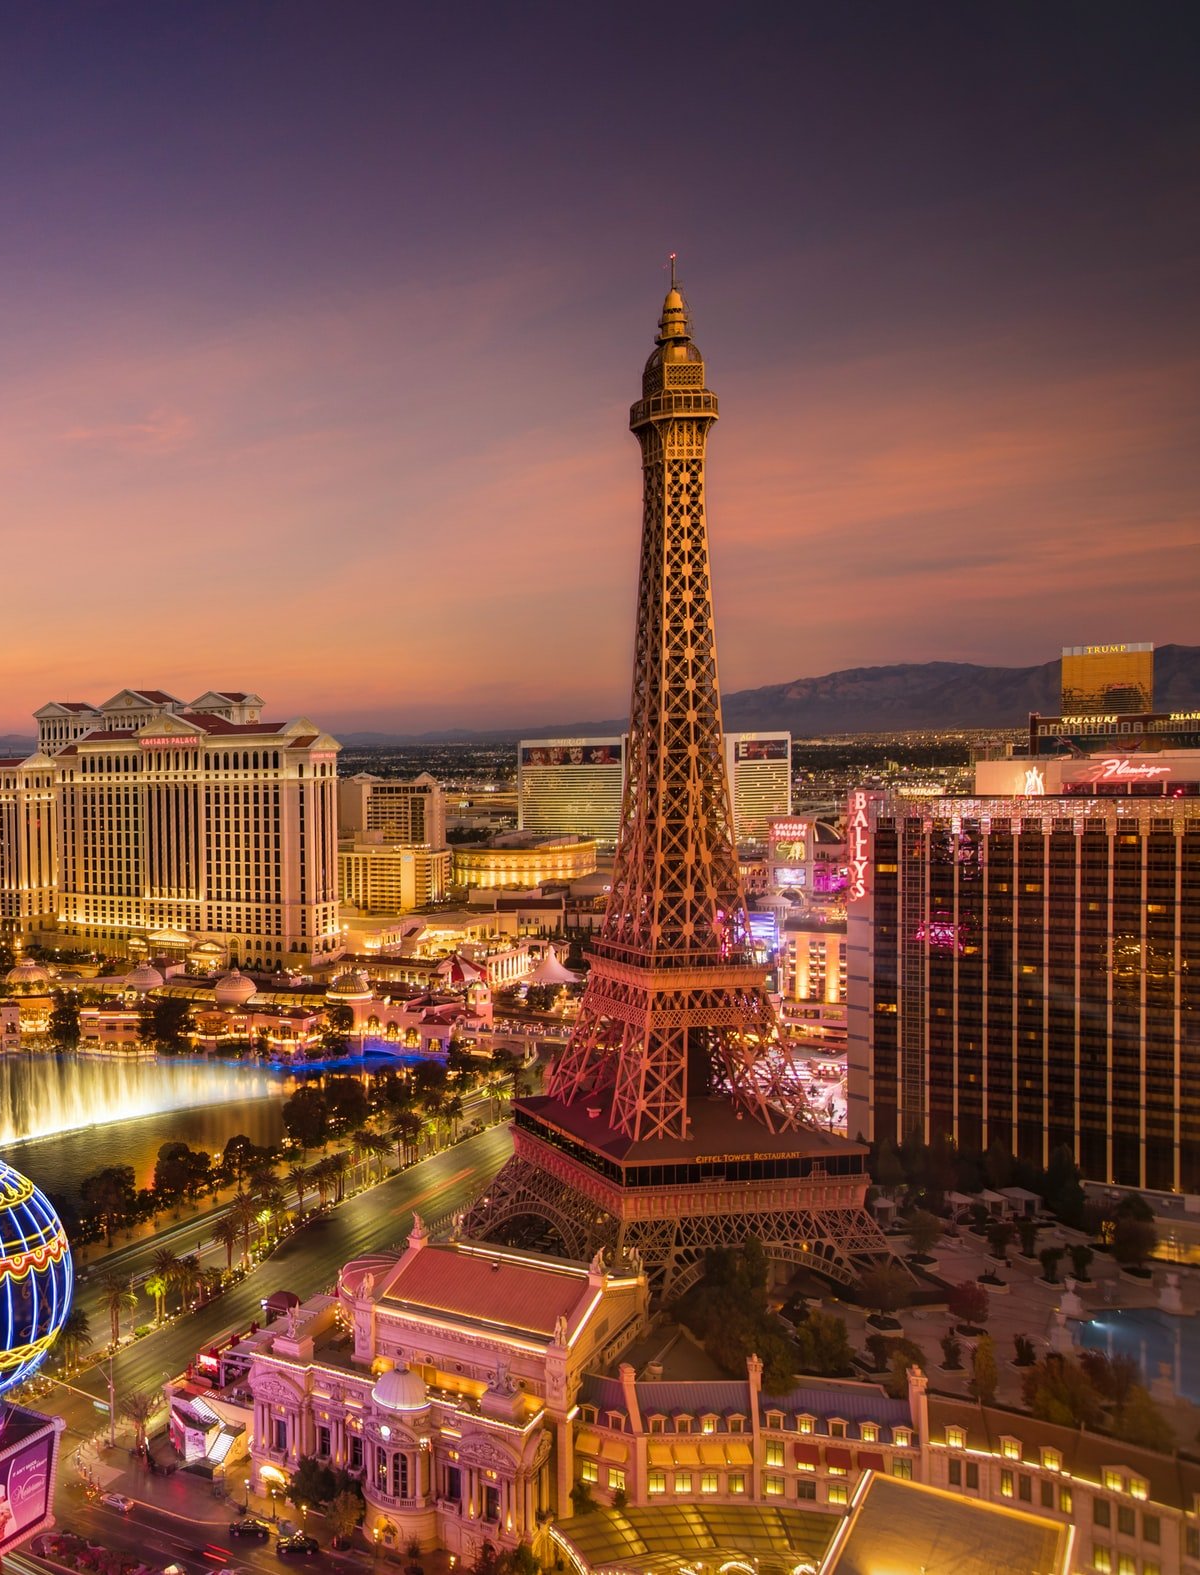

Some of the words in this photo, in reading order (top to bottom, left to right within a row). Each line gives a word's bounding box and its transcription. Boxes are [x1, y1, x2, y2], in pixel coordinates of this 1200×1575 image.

[1087, 645, 1126, 654] TRUMP
[1062, 716, 1118, 724] TREASURE
[1101, 759, 1171, 777] Flamingo
[724, 1154, 751, 1162] TOWER
[754, 1152, 800, 1161] RESTAURANT
